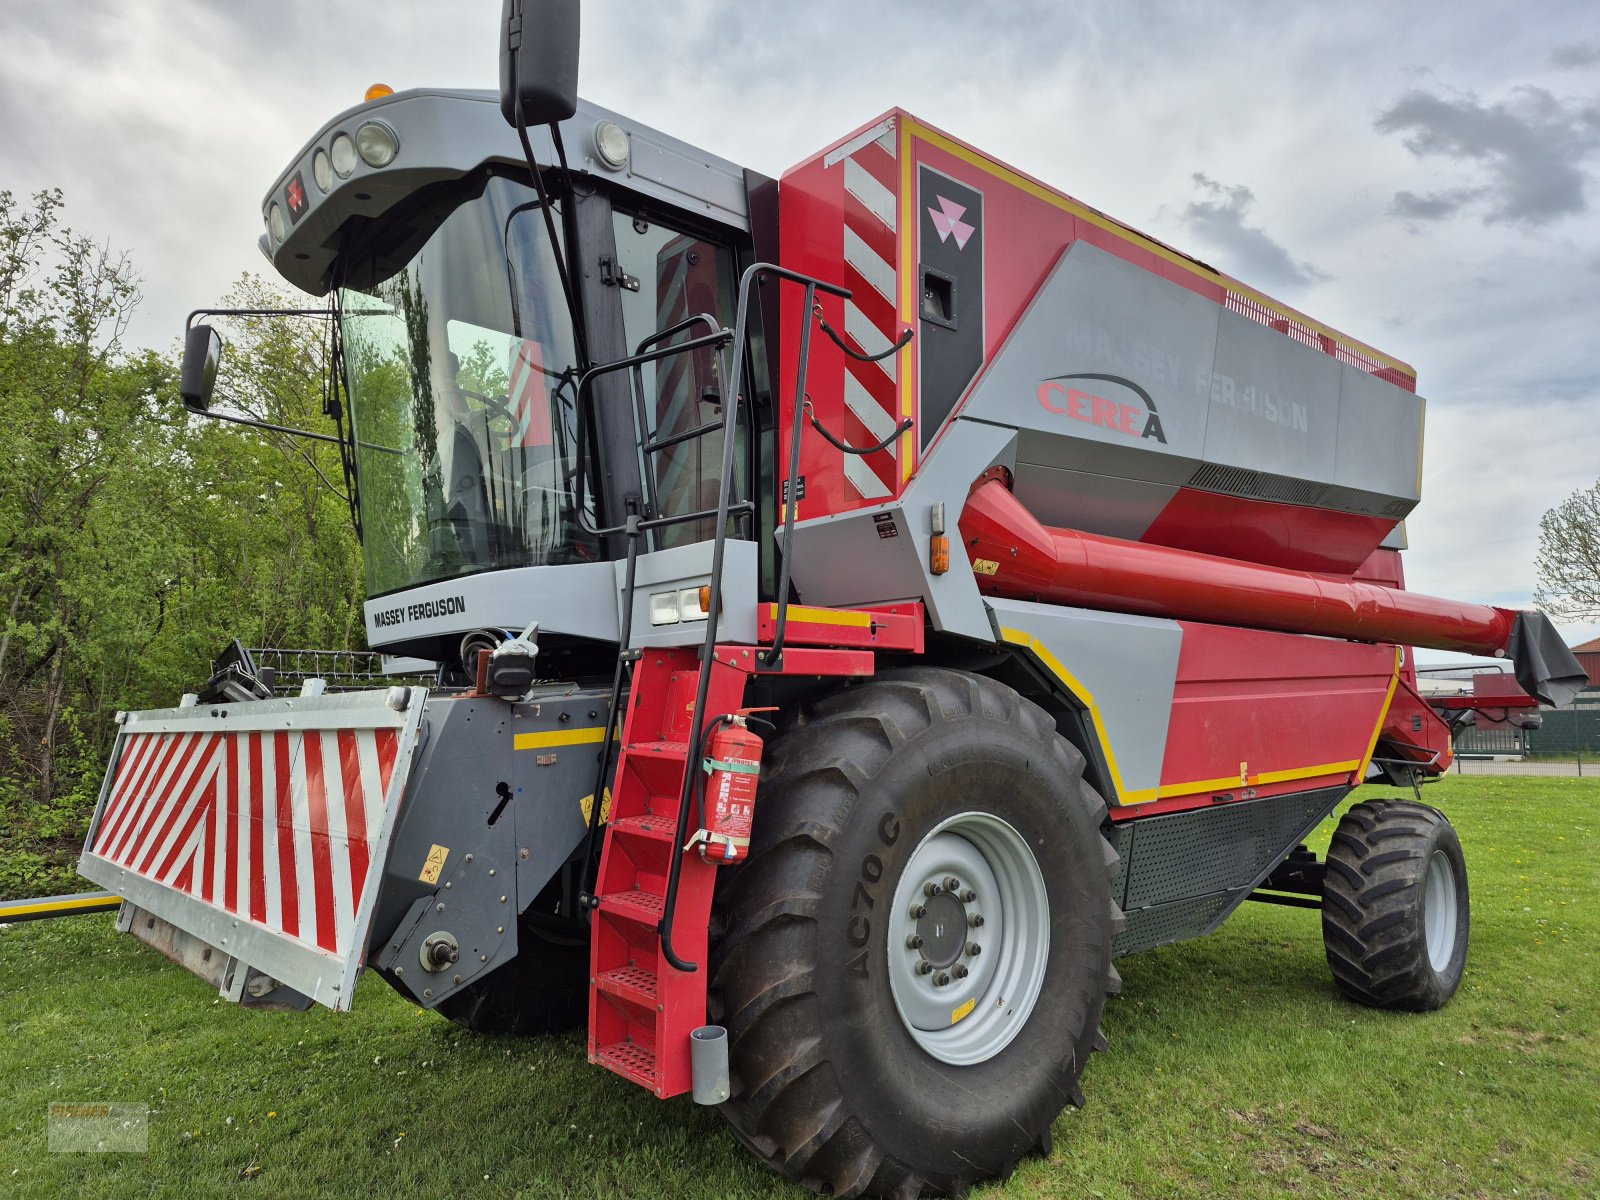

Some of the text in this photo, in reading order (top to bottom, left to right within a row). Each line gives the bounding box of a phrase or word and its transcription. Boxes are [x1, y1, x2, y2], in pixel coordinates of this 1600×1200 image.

[1036, 381, 1168, 445] CEREA
[374, 596, 466, 628] MASSEY FERGUSON
